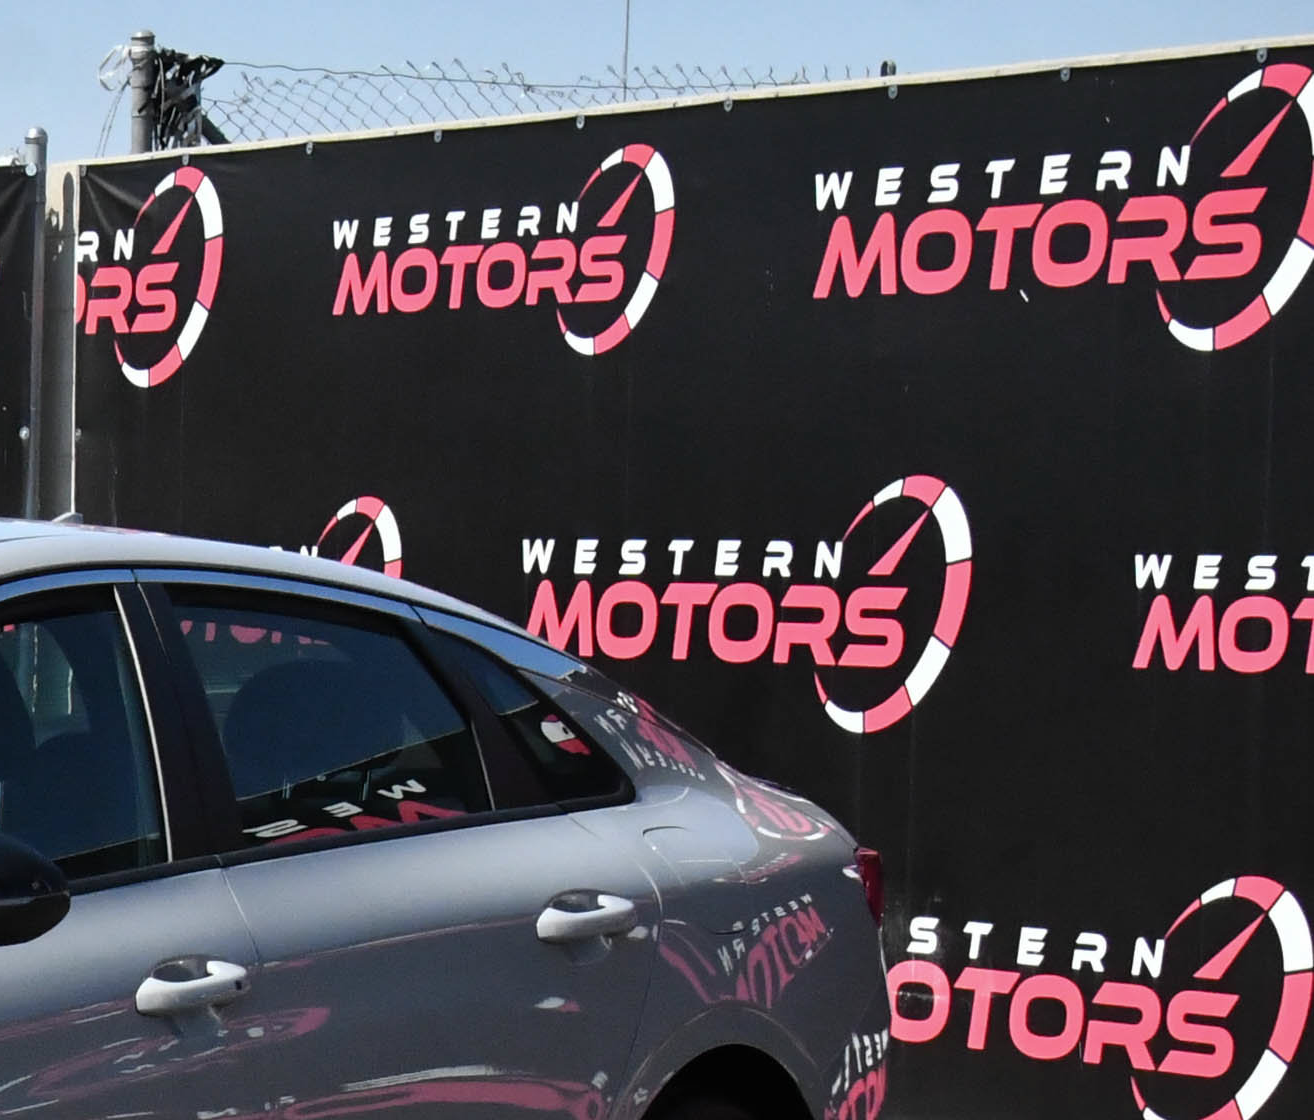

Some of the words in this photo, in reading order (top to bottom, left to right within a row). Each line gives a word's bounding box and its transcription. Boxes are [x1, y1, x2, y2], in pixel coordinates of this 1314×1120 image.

[815, 145, 1190, 211] WESTERN
[333, 200, 578, 250] WESTERN
[813, 187, 1268, 299] MOTORS
[332, 234, 628, 316] MOTORS
[523, 538, 843, 579] WESTERN
[526, 579, 908, 668] MOTORS
[906, 916, 1165, 979] STERN
